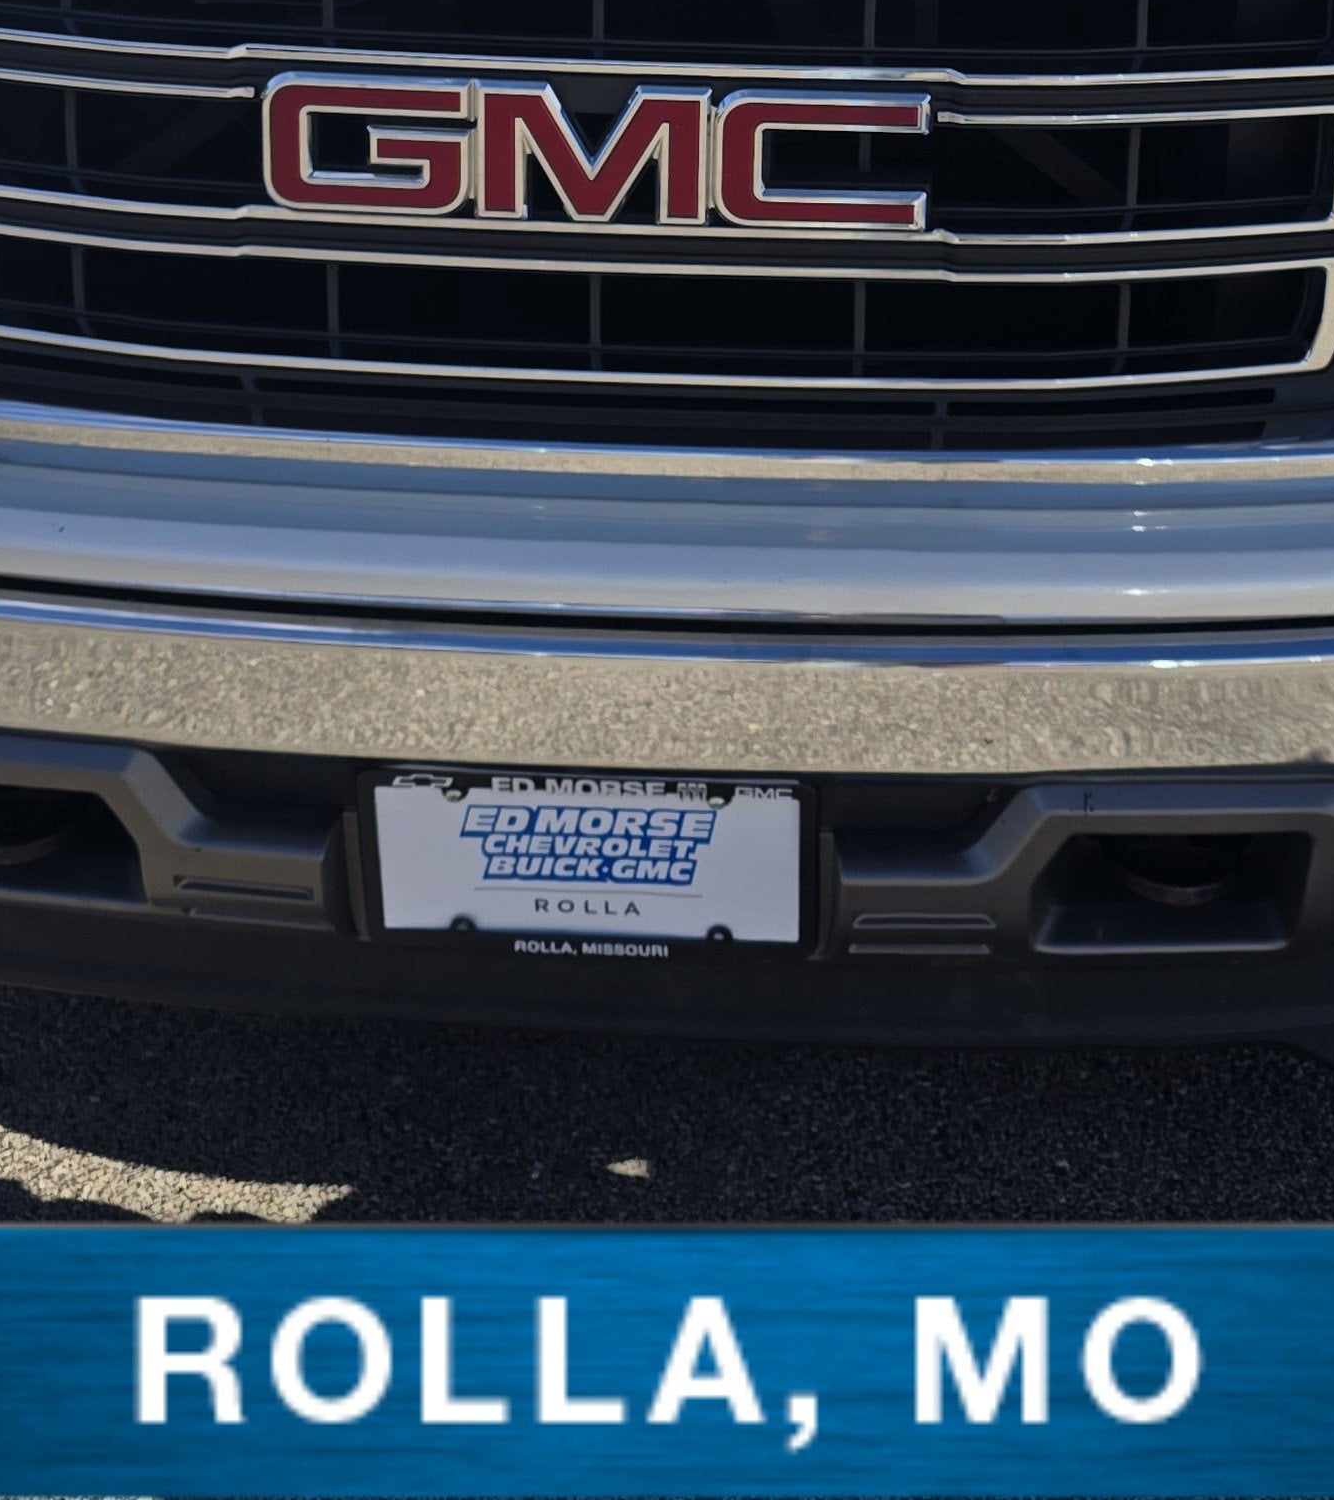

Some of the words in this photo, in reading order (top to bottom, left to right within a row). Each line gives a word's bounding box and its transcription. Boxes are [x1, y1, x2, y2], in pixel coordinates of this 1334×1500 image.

[261, 71, 932, 230] GMC
[490, 776, 536, 795] ED
[544, 778, 667, 798] MORSE
[734, 787, 793, 799] GMC
[463, 807, 531, 833] ED
[534, 808, 715, 838] MORSE
[484, 833, 694, 859] CHEVROLET
[534, 897, 641, 917] ROLLA
[513, 940, 578, 956] ROLLA,
[581, 942, 669, 958] MISSOURI
